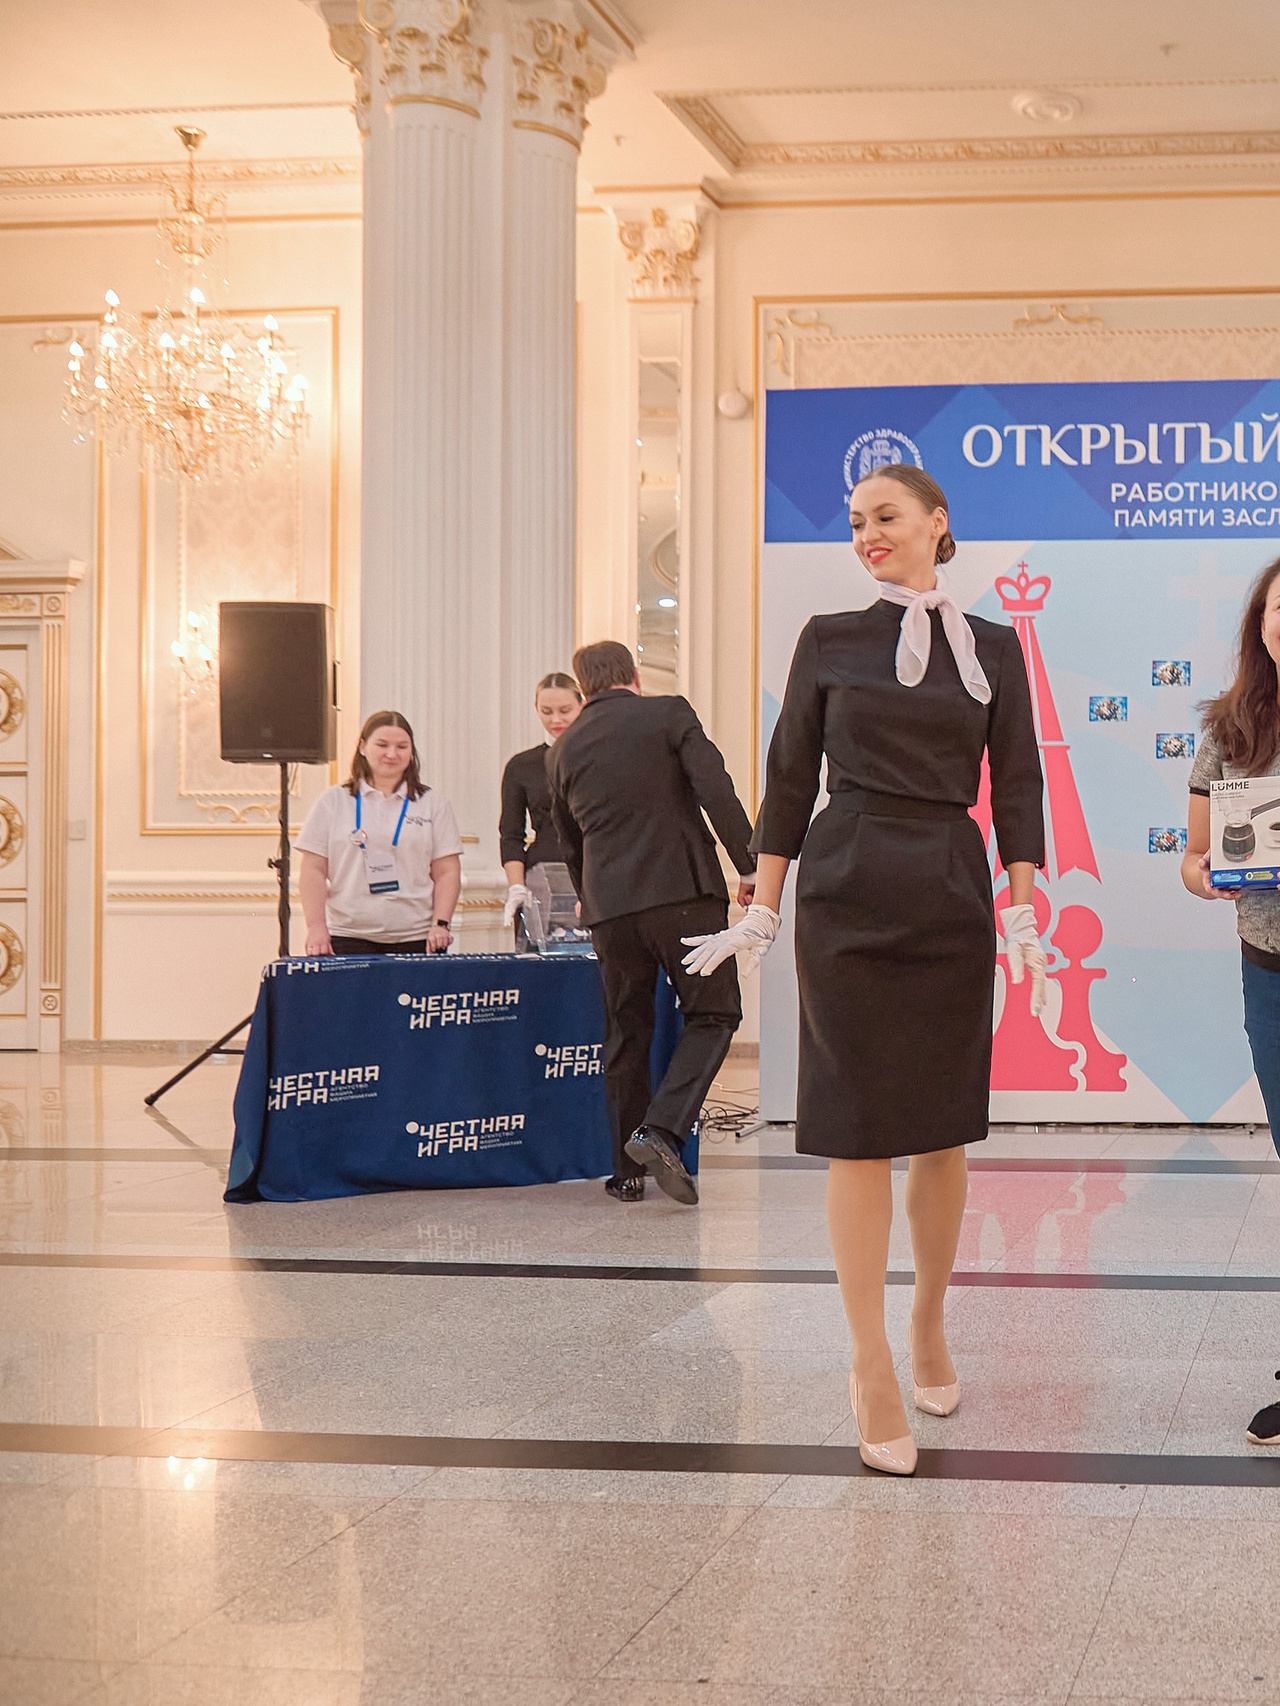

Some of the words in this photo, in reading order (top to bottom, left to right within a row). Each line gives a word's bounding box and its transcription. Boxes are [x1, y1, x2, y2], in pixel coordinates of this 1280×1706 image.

[1114, 508, 1215, 528] ПАМЯТИ
[411, 989, 520, 1013] ЧЕСТНАЯ
[410, 1009, 472, 1030] ИГРА
[547, 1044, 603, 1063] ЧЕСТ
[269, 1065, 380, 1093] ЧЕСТНАЯ
[545, 1060, 601, 1080] ИГРА
[268, 1088, 328, 1111] ИГРА
[420, 1114, 526, 1140] ЧЕСТНАЯ
[417, 1135, 479, 1158] ИГРА
